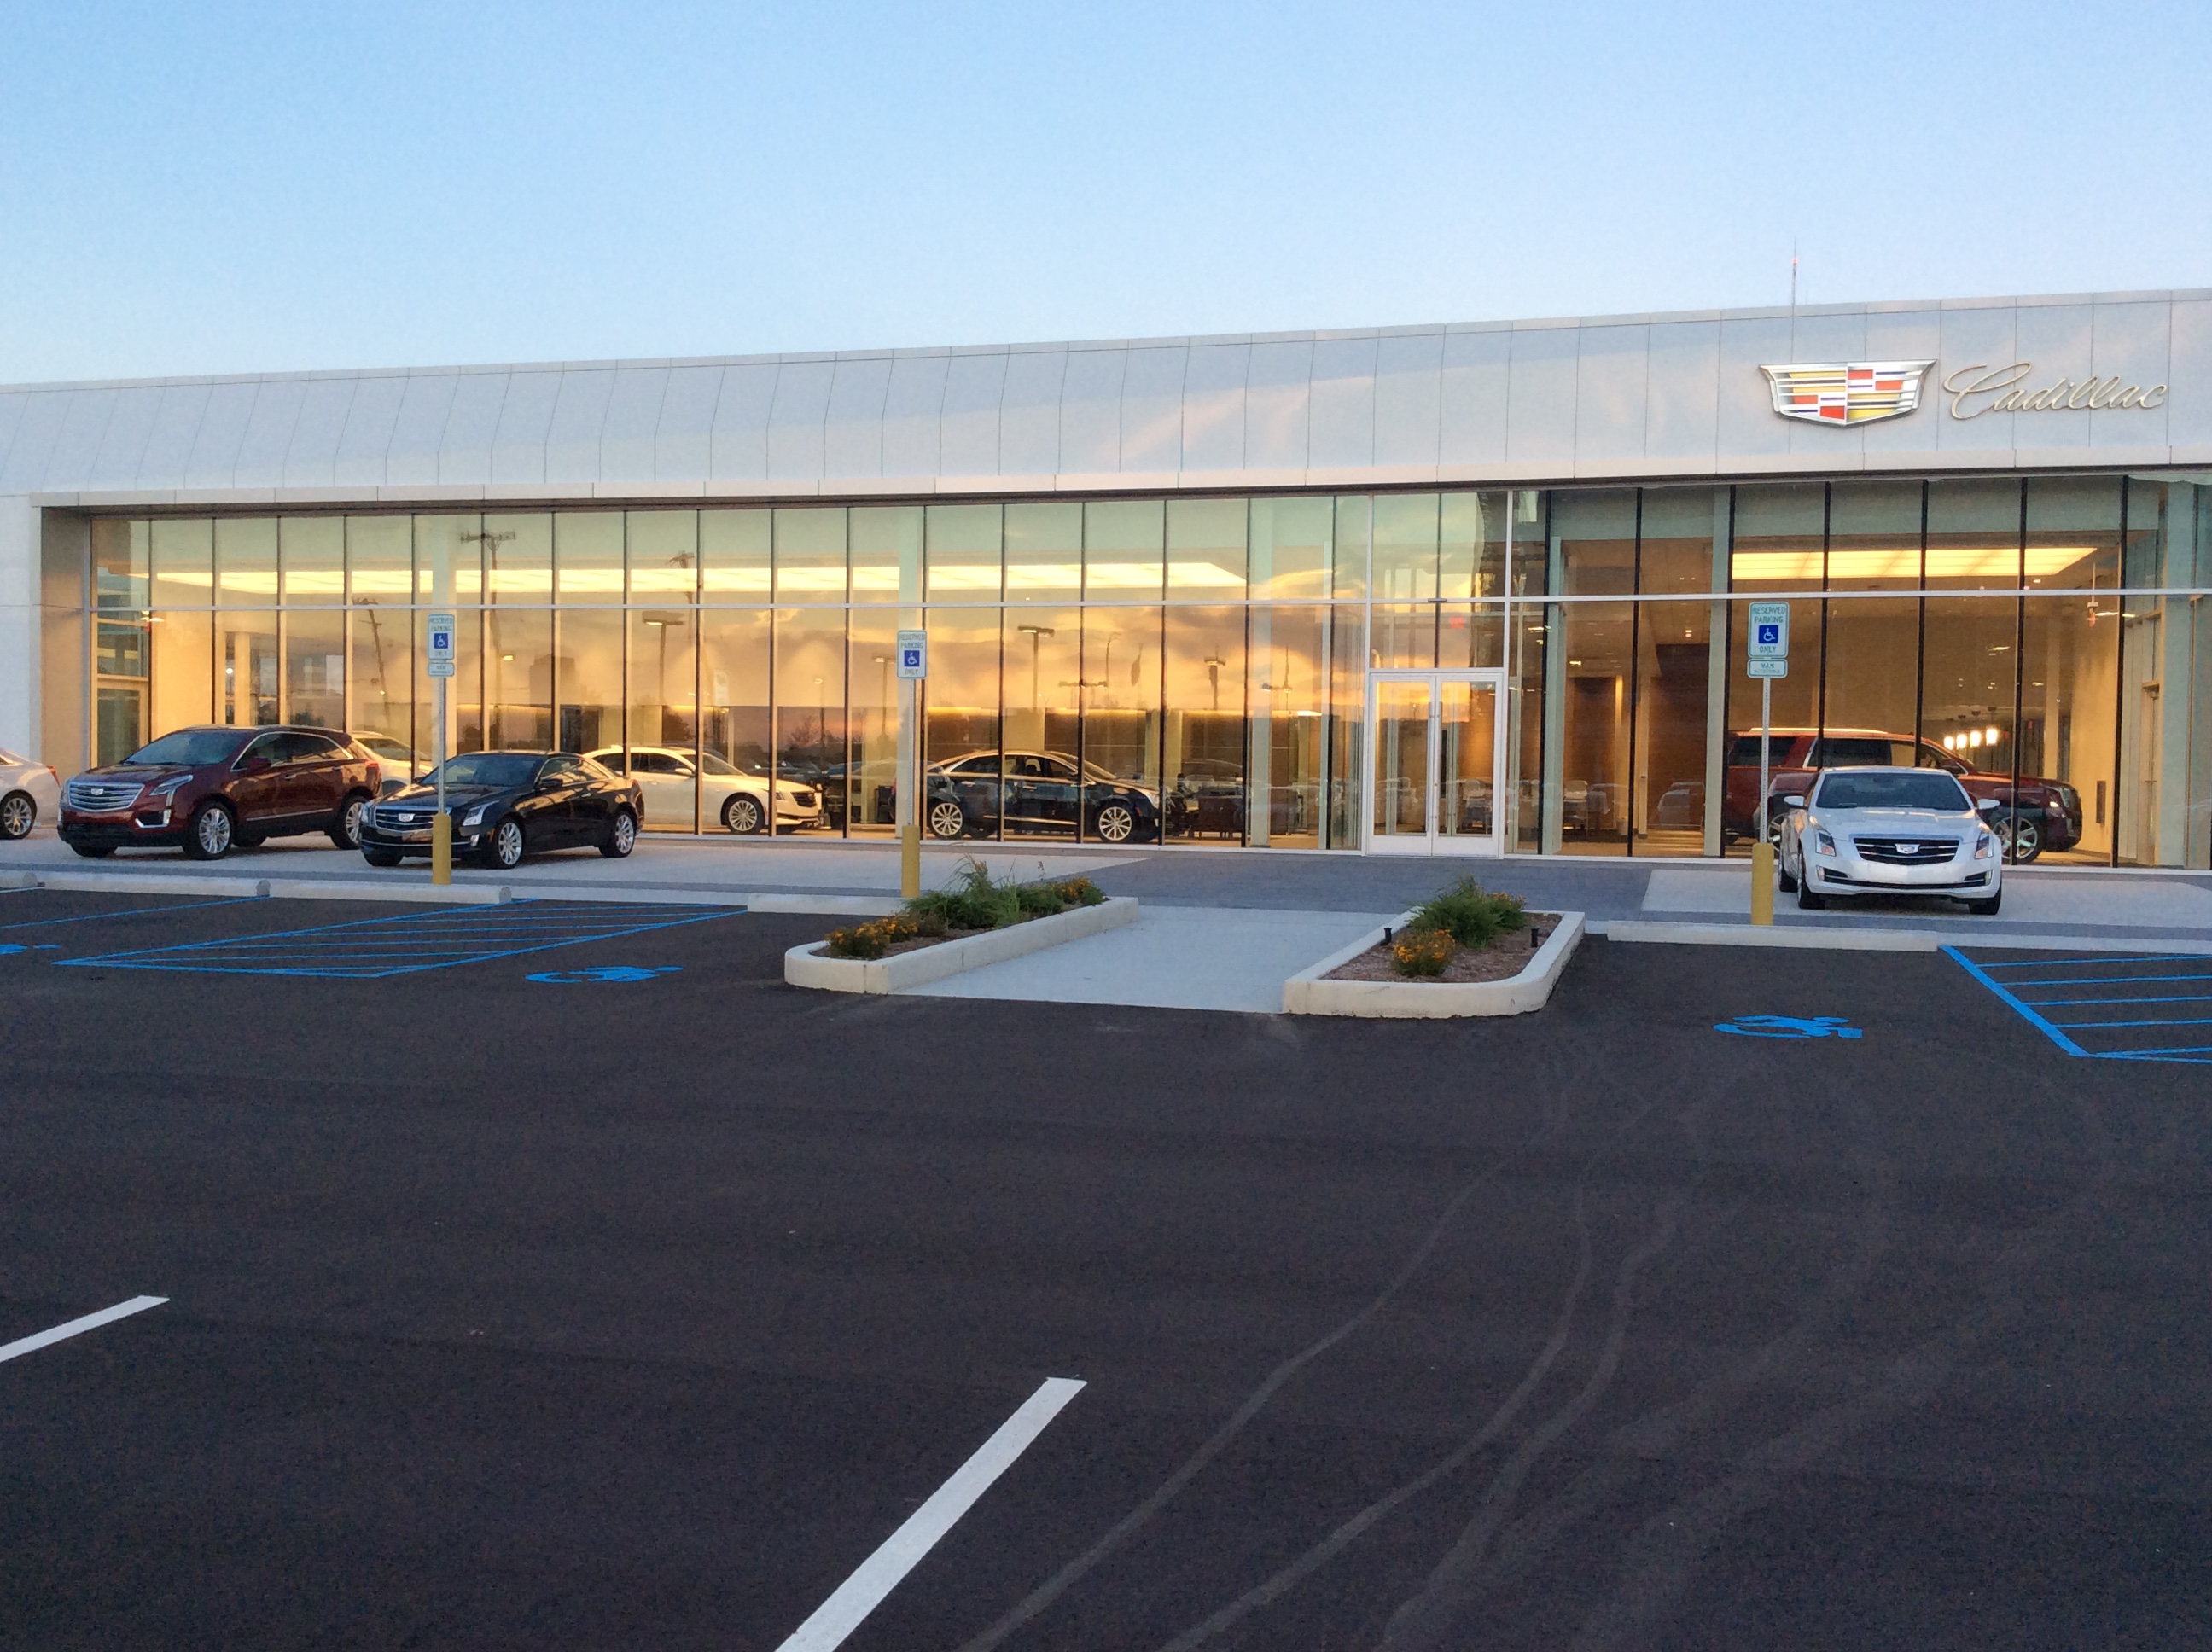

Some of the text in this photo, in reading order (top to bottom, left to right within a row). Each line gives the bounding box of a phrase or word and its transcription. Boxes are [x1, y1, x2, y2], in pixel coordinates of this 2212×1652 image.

[1943, 361, 2168, 420] Cadillac
[1752, 606, 1786, 614] RESERVED
[1754, 615, 1784, 624] PARKING
[1759, 645, 1777, 654] ONLY
